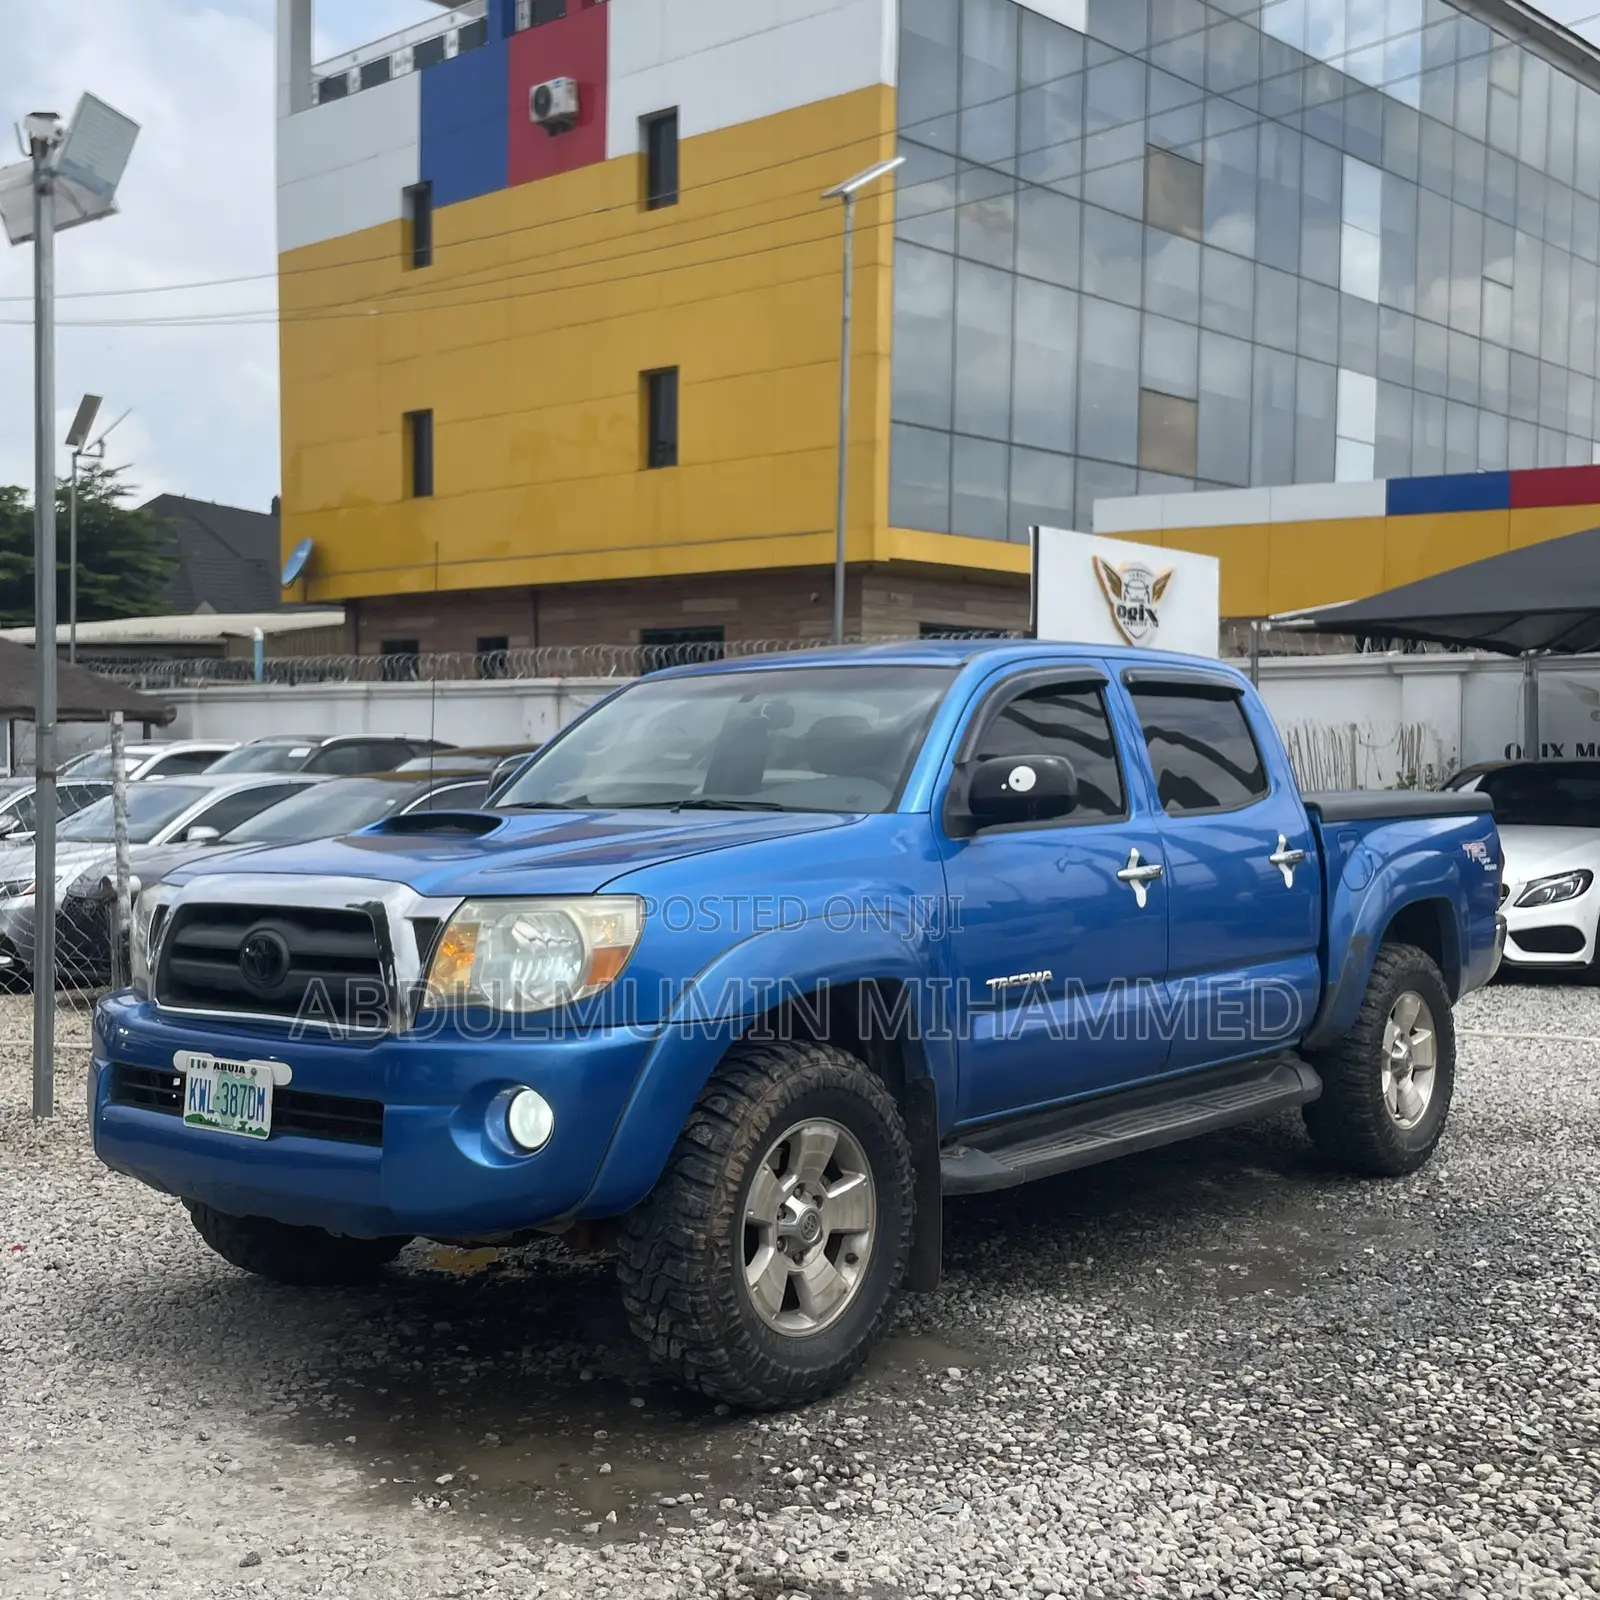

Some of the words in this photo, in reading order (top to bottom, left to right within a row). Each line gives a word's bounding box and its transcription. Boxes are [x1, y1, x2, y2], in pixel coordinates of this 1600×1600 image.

[1504, 742, 1564, 760] OIX
[1575, 742, 1600, 758] M
[213, 1062, 246, 1074] ABUJA
